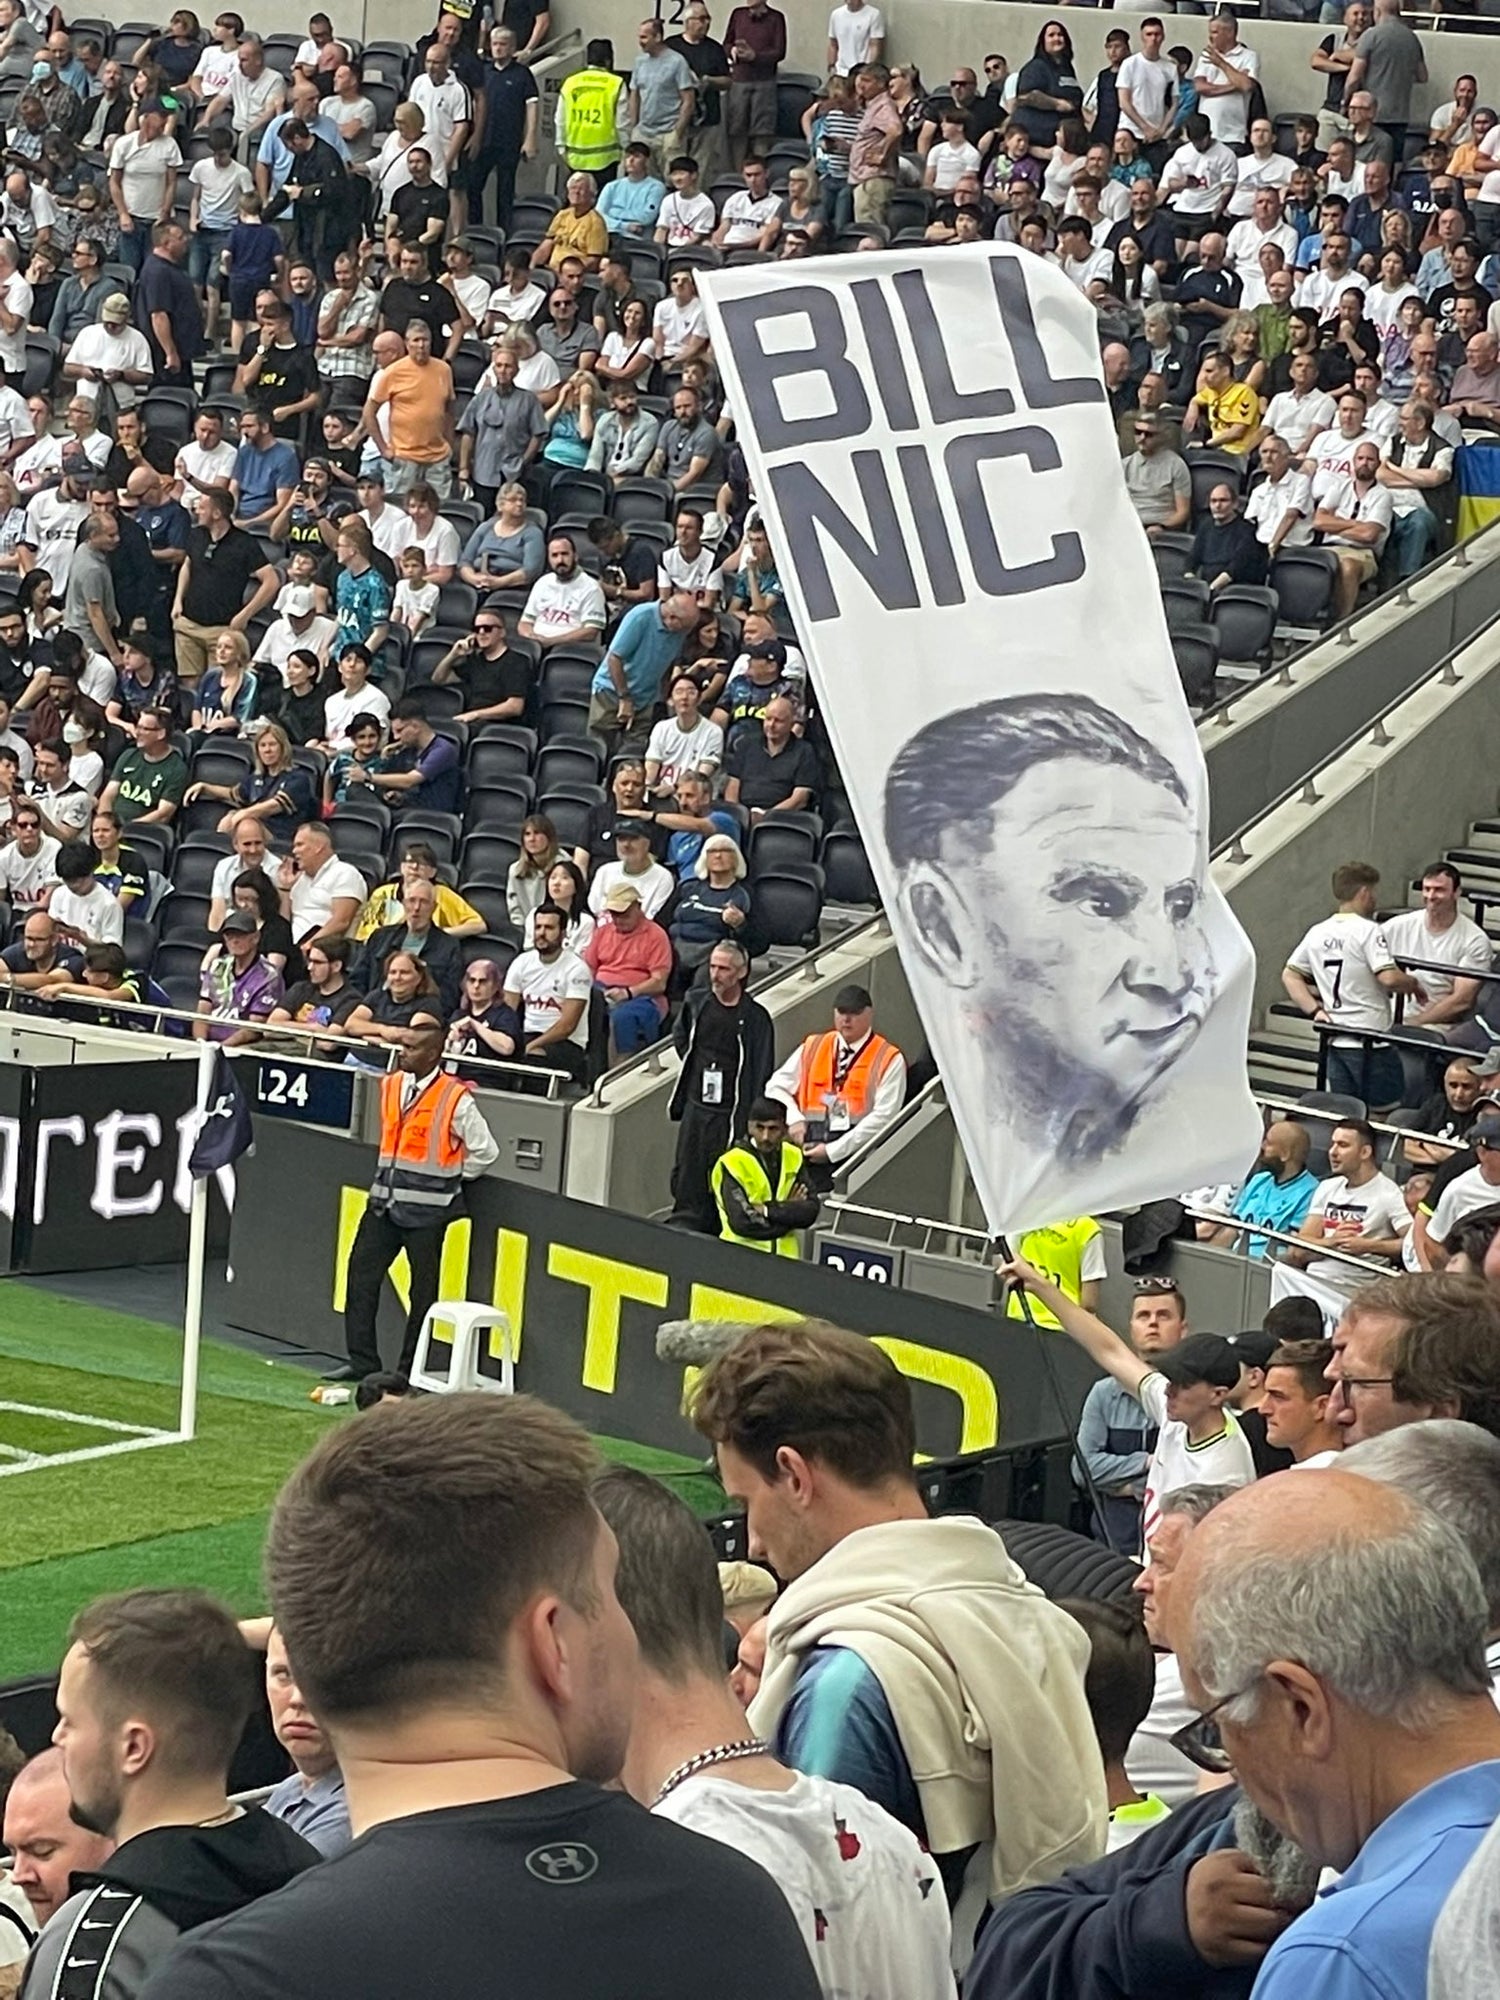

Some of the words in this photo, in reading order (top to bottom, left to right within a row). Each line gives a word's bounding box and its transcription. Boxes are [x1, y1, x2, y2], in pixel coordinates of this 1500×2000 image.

[572, 108, 602, 124] 1142
[718, 256, 1106, 453] BILL
[291, 526, 322, 543] AIA
[767, 425, 1087, 622] NIC
[119, 780, 153, 807] AIA
[1323, 938, 1345, 952] SON
[1323, 958, 1344, 1009] 7
